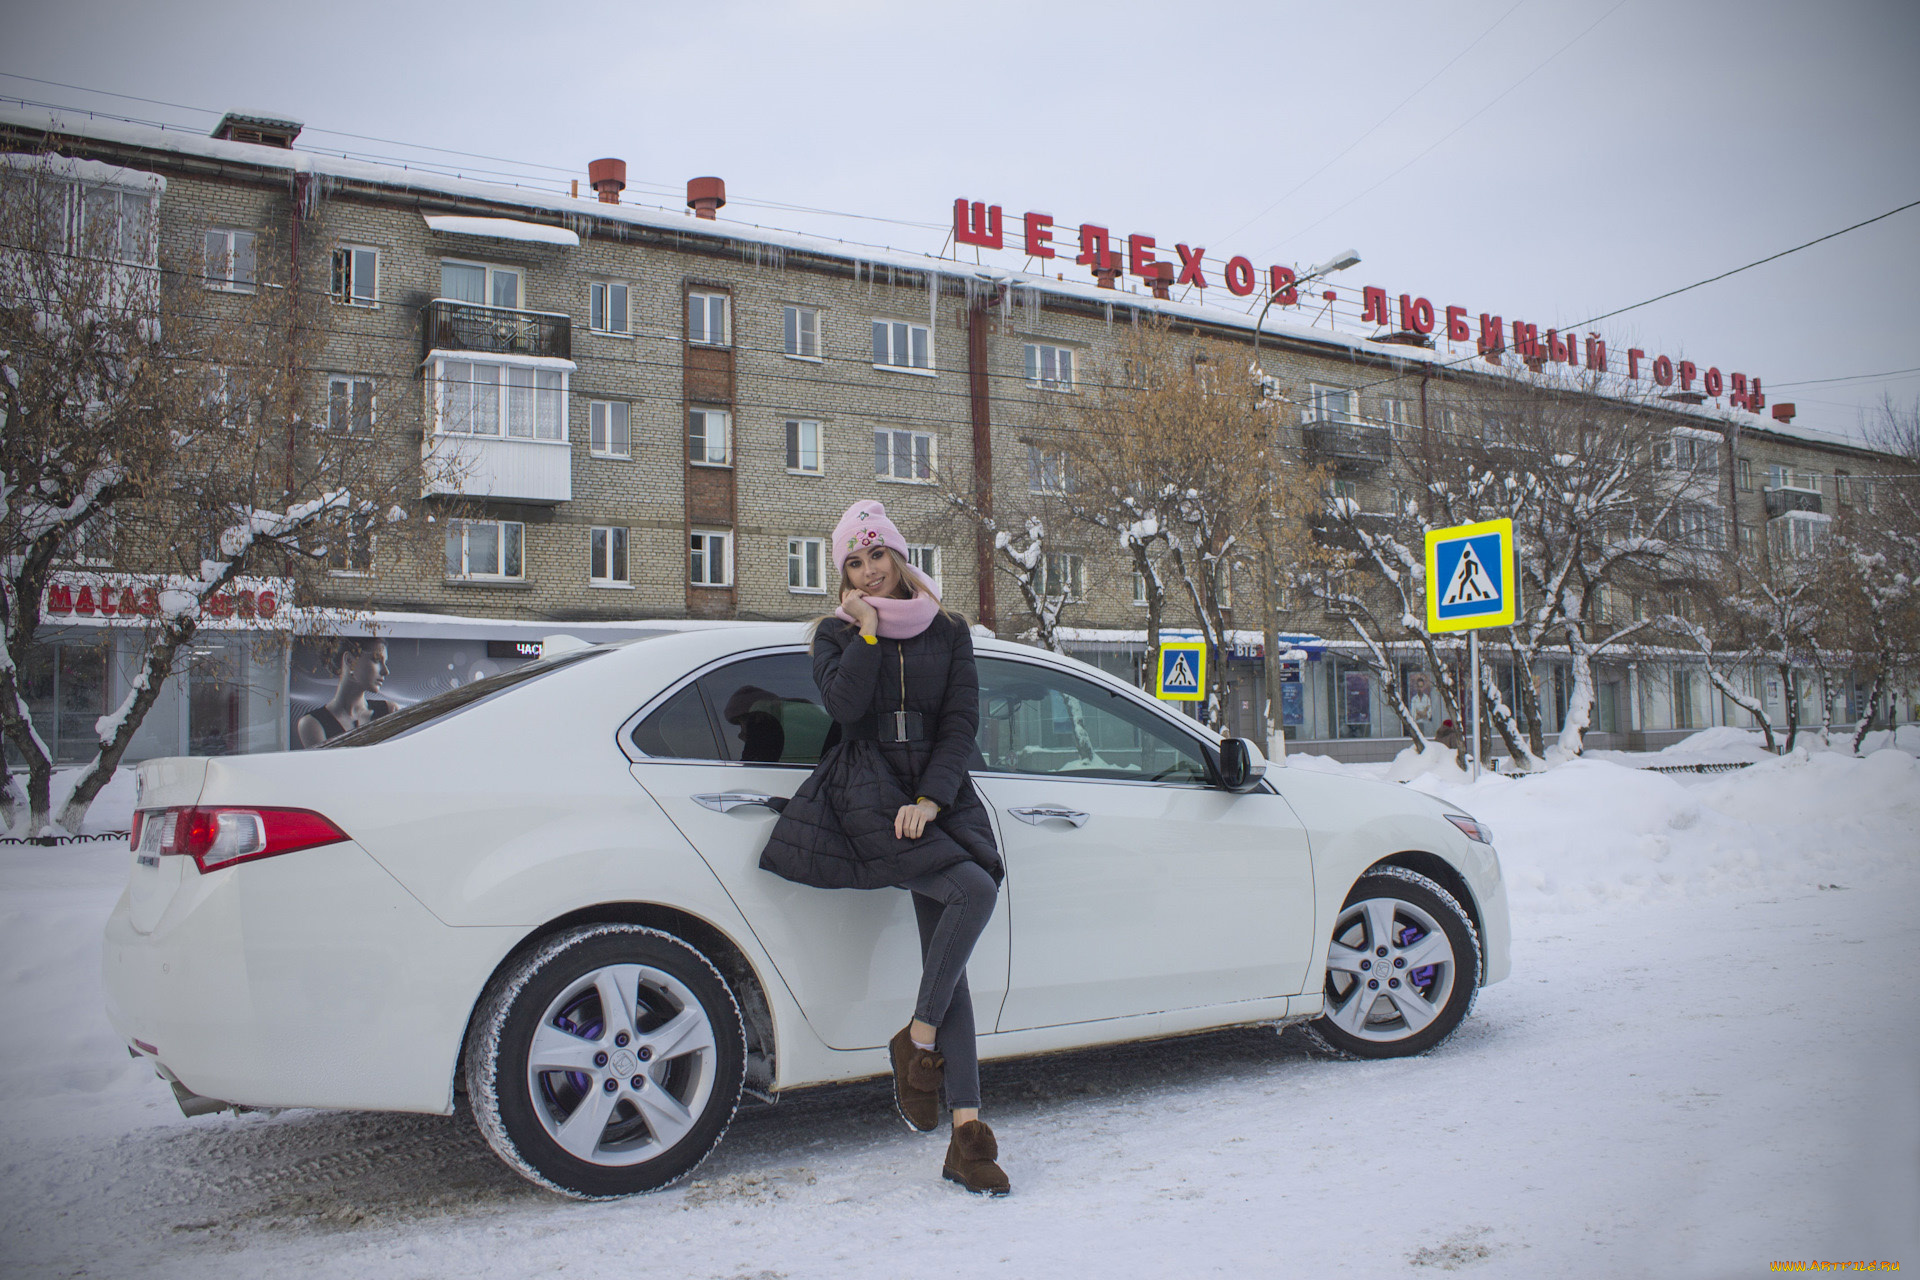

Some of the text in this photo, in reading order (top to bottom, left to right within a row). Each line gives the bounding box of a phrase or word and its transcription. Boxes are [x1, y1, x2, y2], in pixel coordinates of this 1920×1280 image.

[954, 198, 1298, 306] ШЕЛЕХОВ
[1361, 286, 1607, 372] ЛЮБИМЫЙ
[48, 584, 208, 614] МАГАЗ
